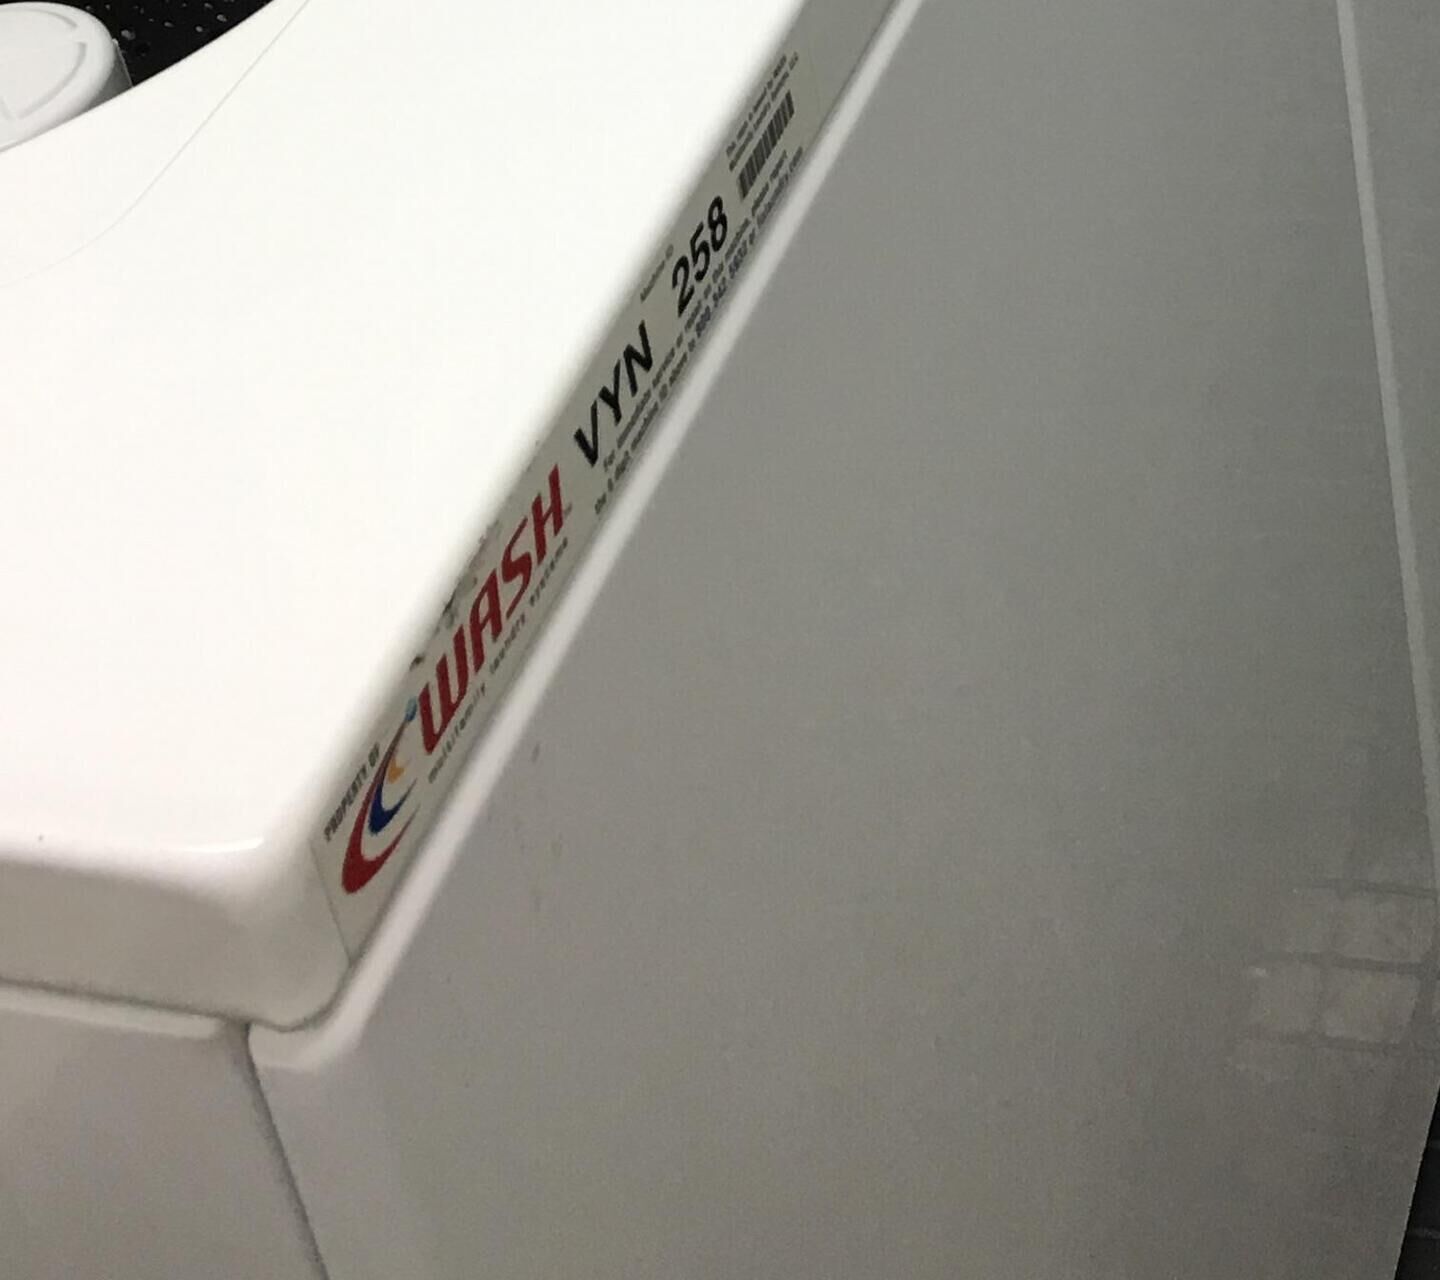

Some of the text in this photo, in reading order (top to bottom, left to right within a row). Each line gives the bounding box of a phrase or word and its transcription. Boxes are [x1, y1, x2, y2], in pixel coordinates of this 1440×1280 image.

[418, 195, 729, 754] WASH VYN 258
